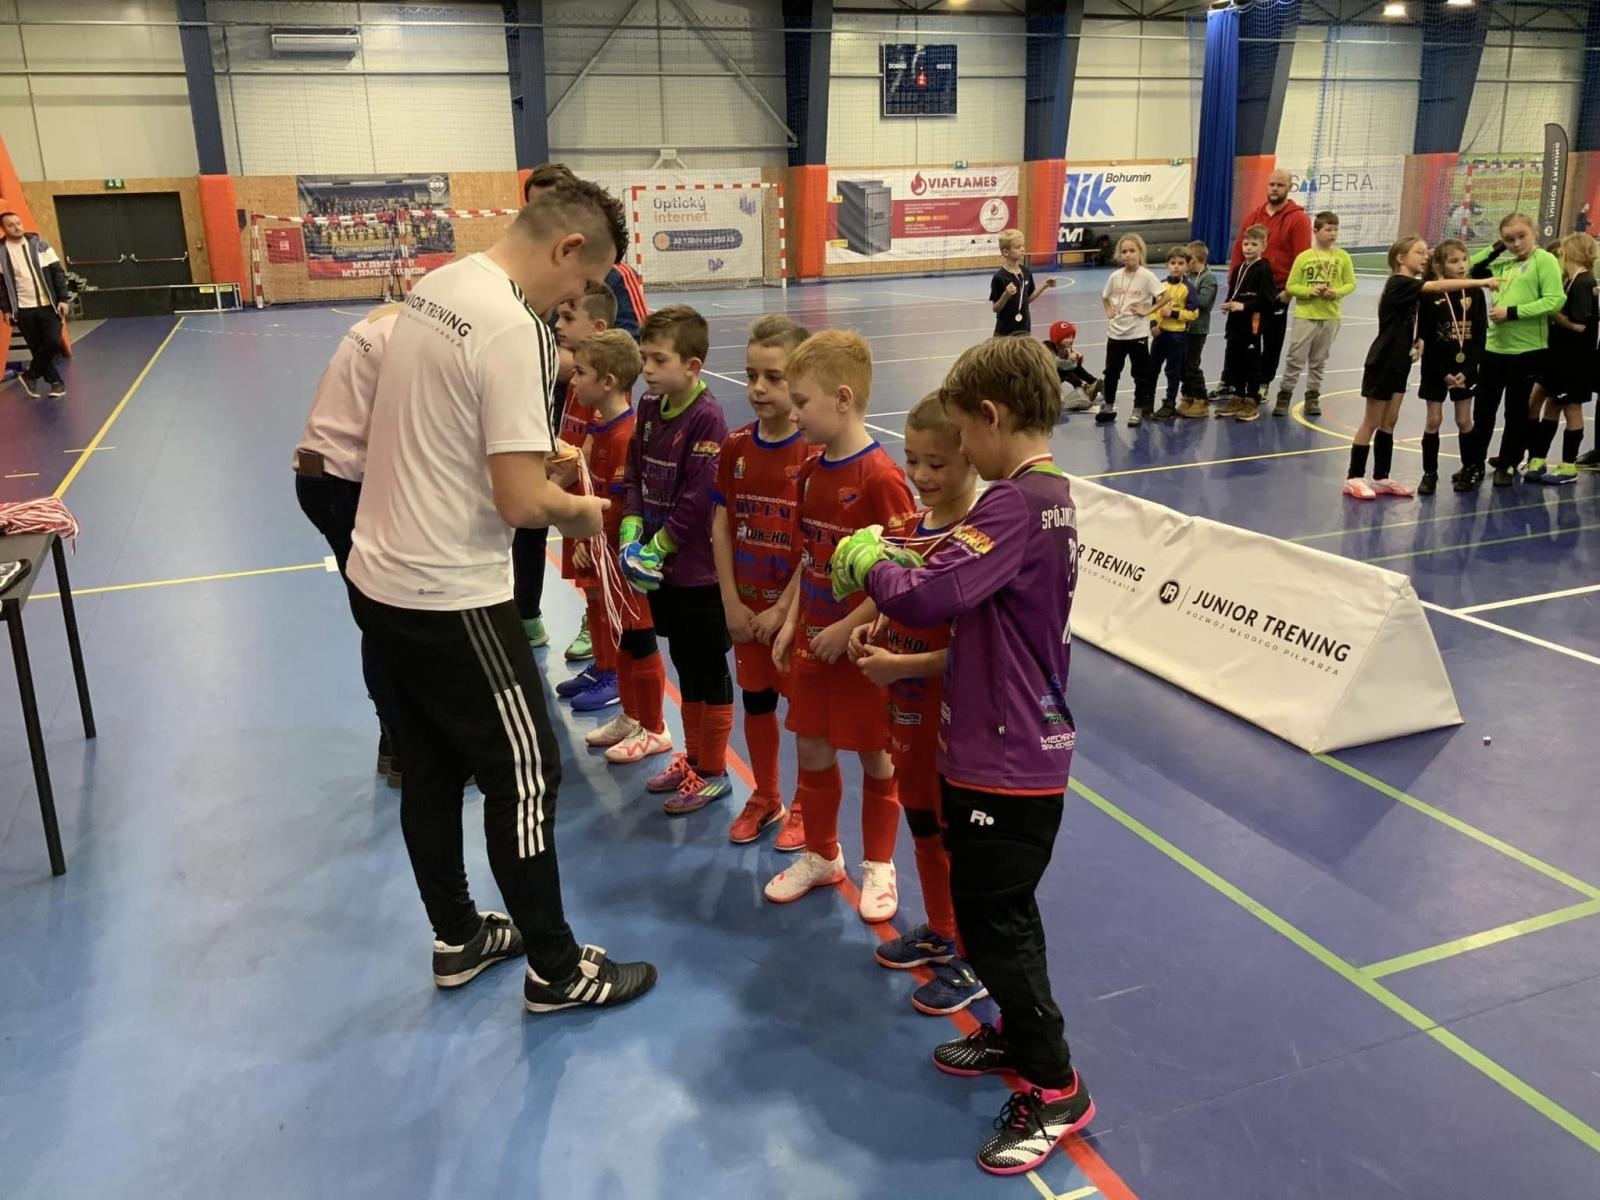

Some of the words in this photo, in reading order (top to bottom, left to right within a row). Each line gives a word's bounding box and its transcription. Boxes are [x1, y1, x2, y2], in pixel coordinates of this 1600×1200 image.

[928, 176, 998, 189] VIAFLAMES
[653, 196, 706, 211] Optický
[654, 211, 708, 223] internet
[424, 301, 472, 338] TRENING
[1087, 547, 1146, 582] TRENING
[1185, 609, 1226, 631] ROZWÓJ
[1229, 625, 1280, 652] MŁODEGO
[1283, 648, 1340, 676] PIŁKARZA
[1192, 589, 1259, 627] JUNIOR
[1262, 614, 1352, 663] TRENING
